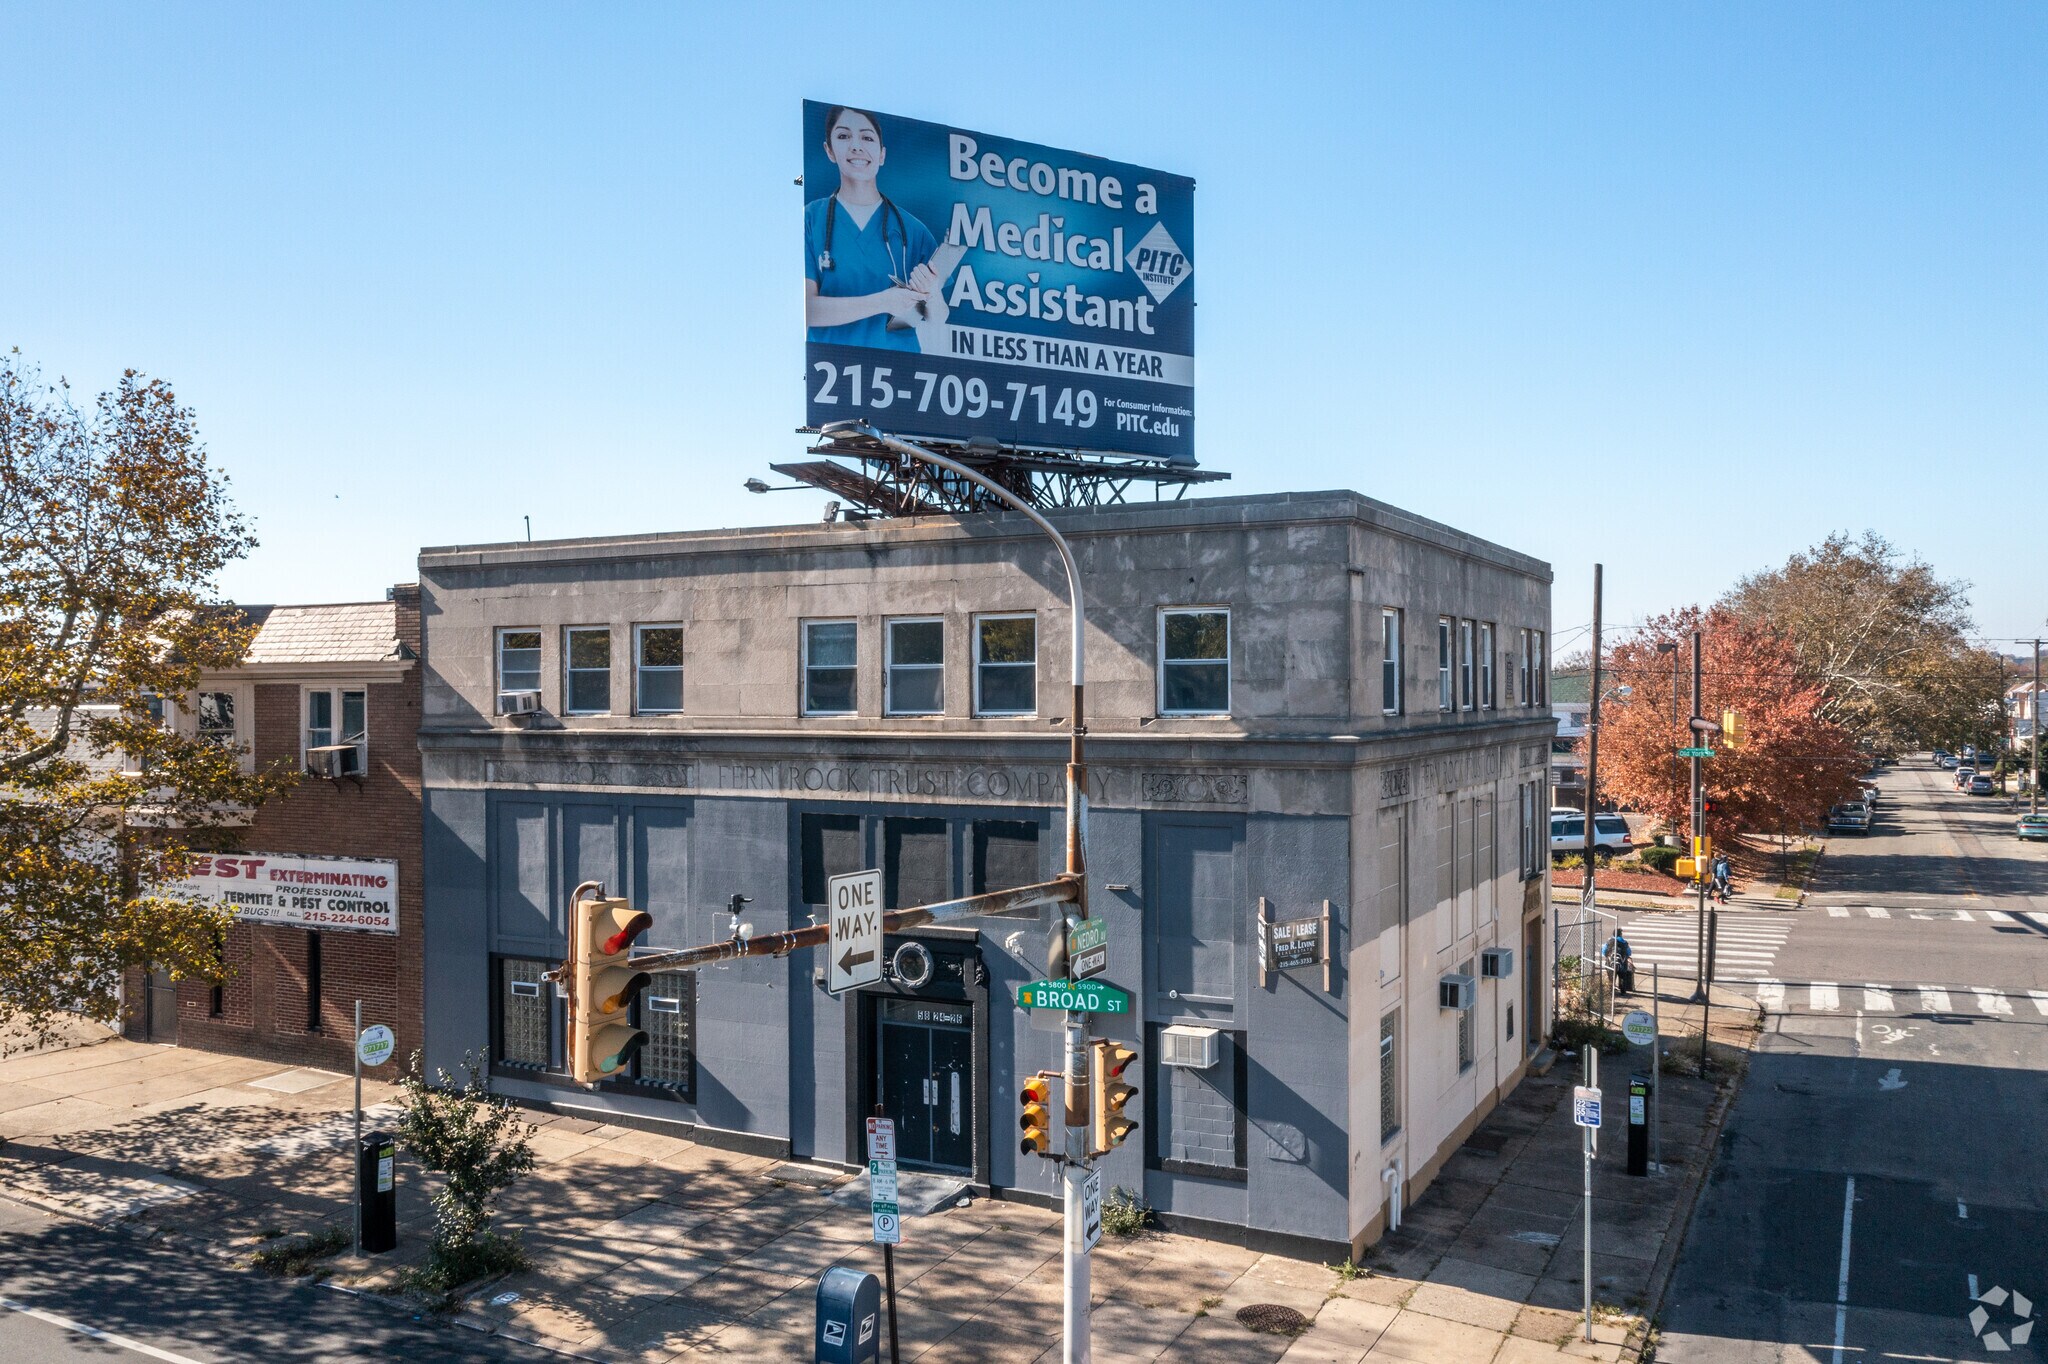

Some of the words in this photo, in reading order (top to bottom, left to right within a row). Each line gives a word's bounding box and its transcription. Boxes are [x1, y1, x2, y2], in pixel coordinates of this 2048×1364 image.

[949, 133, 1123, 209] Become
[1134, 183, 1158, 215] a
[948, 203, 1124, 273] Medical
[1135, 247, 1185, 277] PITC
[1142, 272, 1175, 286] INSTITUTE
[948, 265, 1156, 335] Assistant
[951, 330, 975, 355] IN
[982, 333, 1028, 361] LESS
[1032, 340, 1089, 369] THAN
[1095, 349, 1109, 371] A
[1112, 350, 1164, 378] YEAR
[813, 360, 1098, 429] 215-709-7149
[1103, 397, 1115, 407] For
[1116, 399, 1151, 412] Consumer
[1152, 403, 1192, 417] Information:
[1116, 412, 1180, 437] PITC.edu
[718, 765, 774, 790] FERN
[788, 766, 861, 793] ROCK
[871, 768, 954, 796] TRUST
[966, 771, 1112, 800] COMPAY
[269, 868, 388, 889] EXTERMINATING
[224, 890, 273, 906] TERMITE
[278, 896, 286, 908] &
[292, 896, 322, 910] PEST
[327, 900, 390, 914] CONTROL
[275, 885, 366, 899] PROFESSIONAL
[838, 882, 874, 910] ONE
[226, 906, 242, 914] BD
[244, 906, 269, 916] BUGS
[304, 912, 390, 926] 215-224-6054
[838, 911, 875, 942] WAY
[1273, 926, 1291, 939] SALE
[1296, 923, 1317, 936] LEASE
[1077, 928, 1099, 951] NEDRO
[1275, 943, 1289, 952] FRED
[1290, 941, 1297, 950] R.
[1297, 940, 1315, 949] LEVINE
[1081, 957, 1092, 972] ONE
[1092, 952, 1104, 968] WAY
[1036, 990, 1100, 1010] BROAD
[1107, 1000, 1122, 1012] ST
[872, 1162, 877, 1173] 2
[1084, 1176, 1099, 1201] ONE
[1085, 1196, 1099, 1220] WAY
[882, 1217, 889, 1228] P
